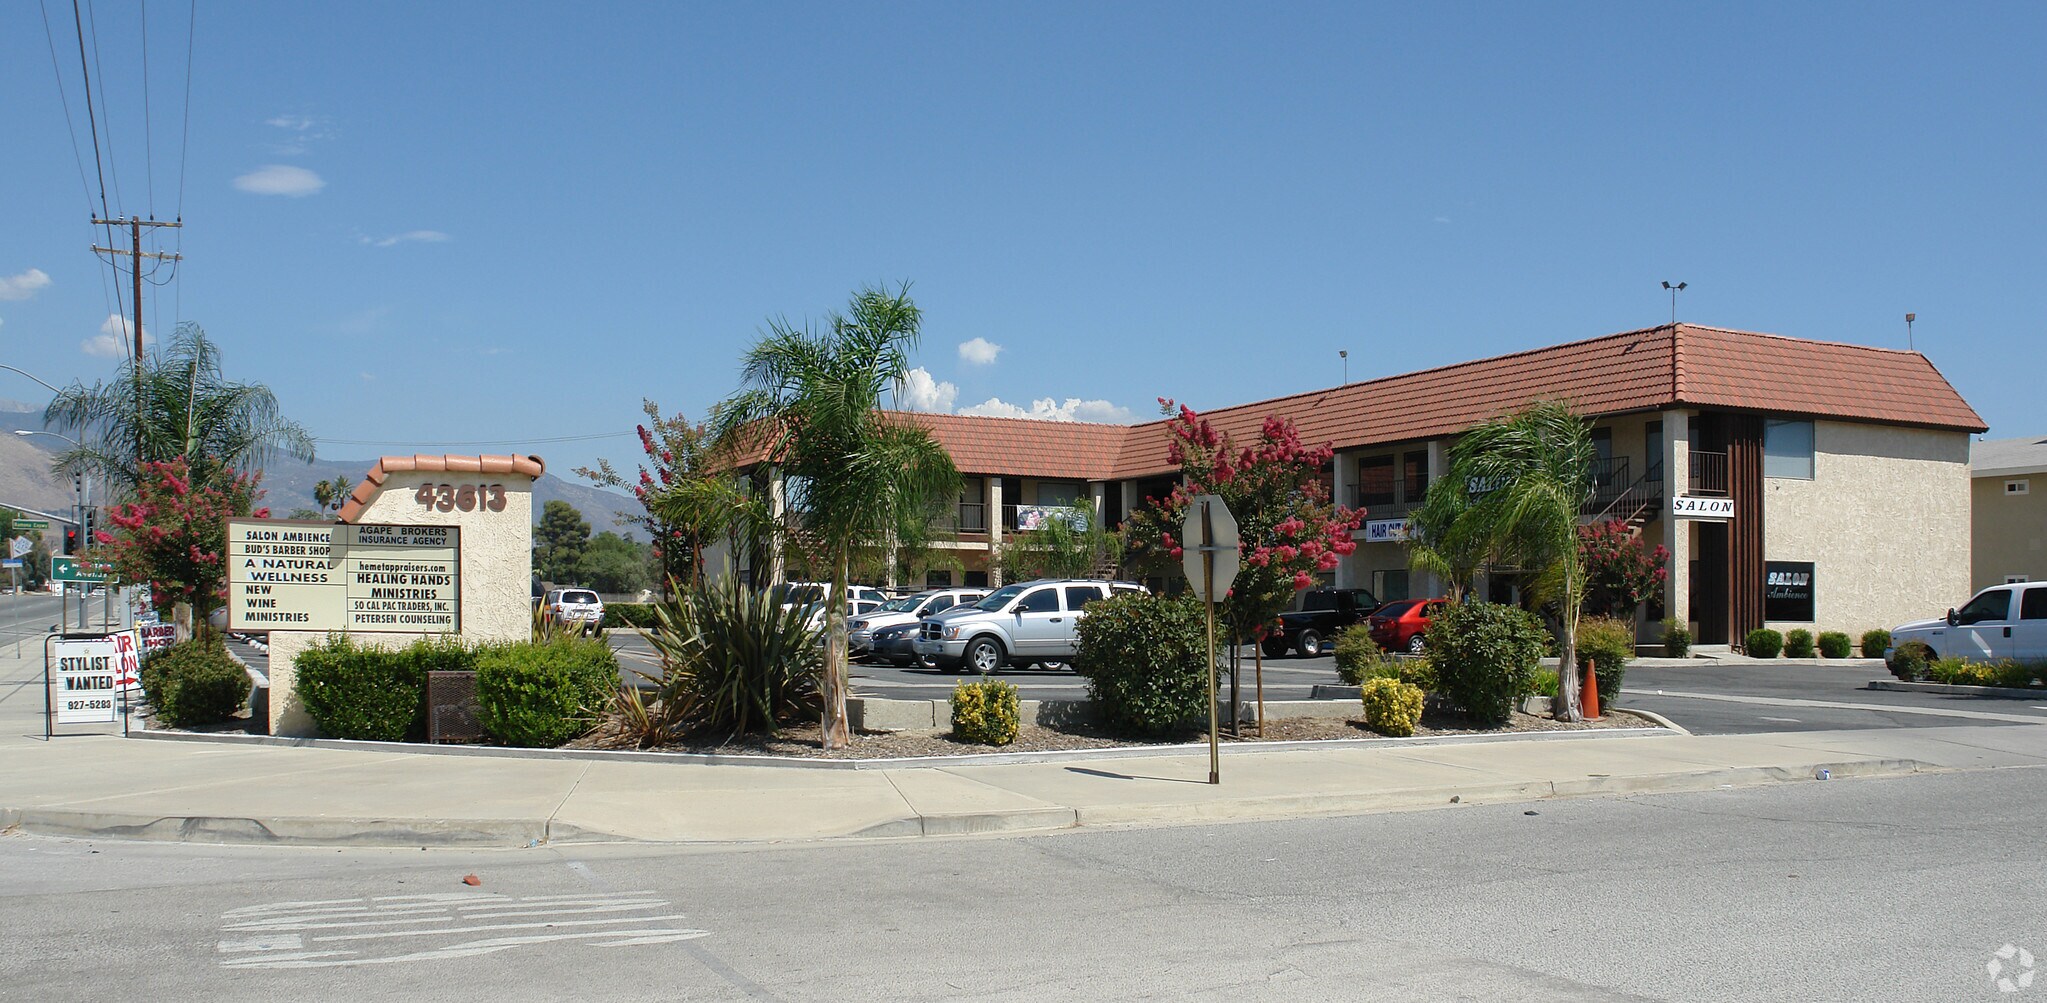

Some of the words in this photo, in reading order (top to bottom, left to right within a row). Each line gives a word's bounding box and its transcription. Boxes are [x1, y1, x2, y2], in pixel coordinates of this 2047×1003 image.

[415, 483, 507, 513] 43613
[1674, 500, 1733, 512] SALON
[360, 527, 392, 535] AGAPE
[401, 527, 447, 536] BROKERS
[1371, 523, 1387, 538] HAIR
[246, 531, 278, 540] SALON
[283, 532, 330, 542] AMBIENCE
[359, 536, 408, 544] INSURANCE
[412, 537, 447, 545] AGENCY
[245, 545, 270, 554] BUD'S
[273, 545, 306, 555] BARBER
[309, 546, 331, 555] SHOP
[245, 559, 256, 567] A
[262, 559, 334, 569] NATURAL
[360, 561, 446, 572] hemetappraisers.com
[250, 572, 328, 582] WELLNESS
[357, 573, 407, 584] HEALING
[411, 575, 450, 585] HANDS
[1767, 571, 1810, 586] SALON
[246, 585, 272, 594] NEW
[371, 588, 437, 599] MINISTRIES
[1767, 586, 1809, 600] Ambience
[246, 599, 276, 608] WINE
[366, 601, 380, 610] CAL
[382, 601, 396, 610] PAC
[435, 602, 449, 611] INC.
[245, 612, 309, 622] MINISTRIES
[355, 614, 397, 623] PETERSEN
[400, 615, 451, 624] COUNSELING
[141, 626, 175, 638] BARBER
[143, 638, 175, 648] SHOP
[60, 657, 110, 671] STYLIST
[65, 676, 113, 690] WANTED
[68, 700, 112, 710] 927-5283
